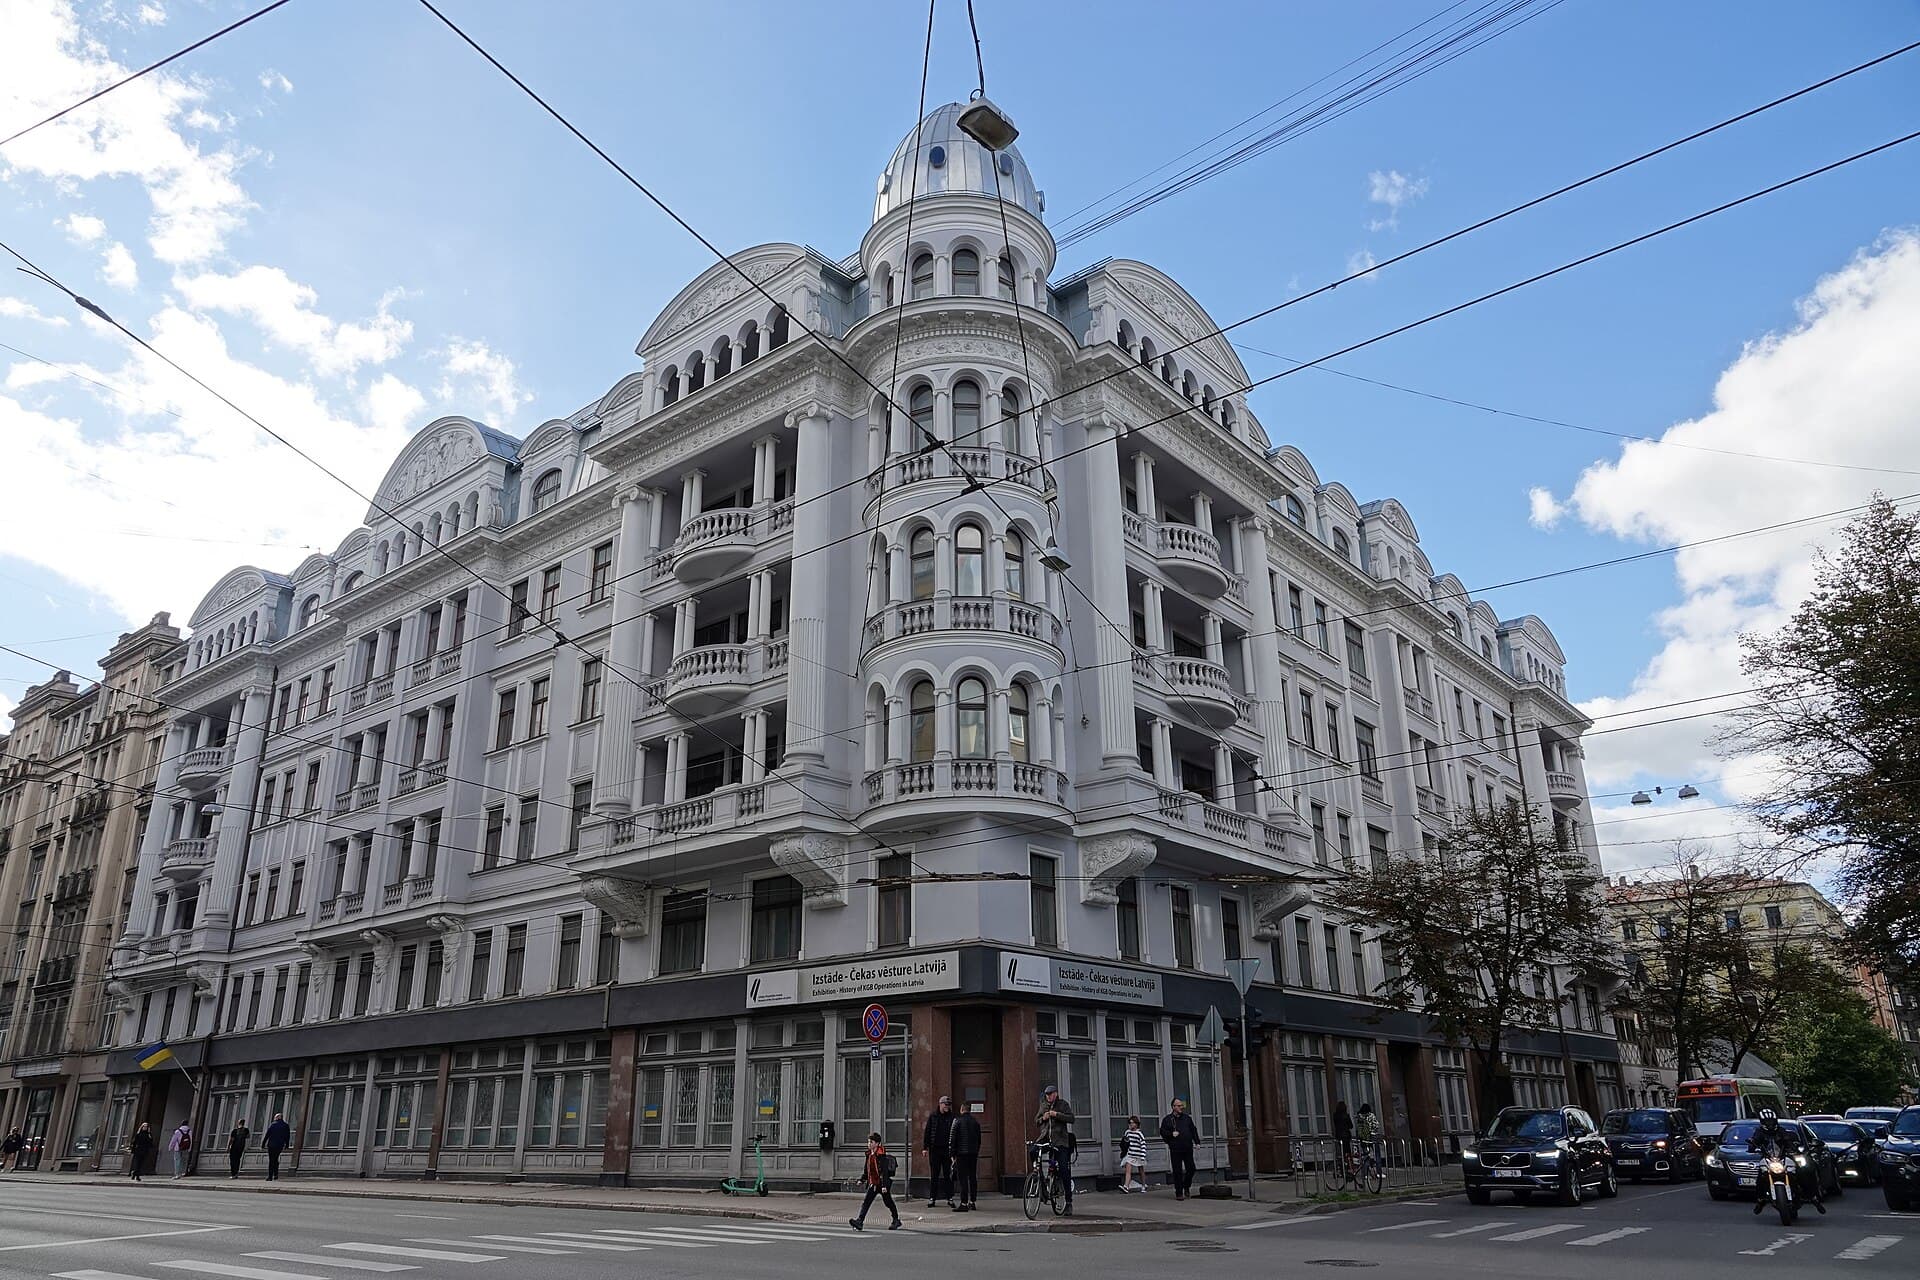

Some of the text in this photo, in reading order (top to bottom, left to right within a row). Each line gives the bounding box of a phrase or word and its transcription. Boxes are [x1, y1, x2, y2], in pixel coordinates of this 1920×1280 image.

[812, 970, 843, 985] Izstāde
[849, 967, 876, 981] Čekas
[878, 965, 912, 978] vēsture
[914, 959, 947, 976] Latvijā
[1058, 967, 1085, 981] Izstāde
[1089, 968, 1109, 984] Čekas
[1110, 974, 1134, 987] vēsture
[1134, 976, 1156, 993] Latvijā
[812, 988, 836, 997] Exhibition
[840, 985, 856, 994] History
[857, 984, 863, 992] of
[863, 983, 874, 991] KGB
[874, 980, 902, 991] Operations
[902, 980, 908, 988] in
[908, 978, 925, 987] Latvia
